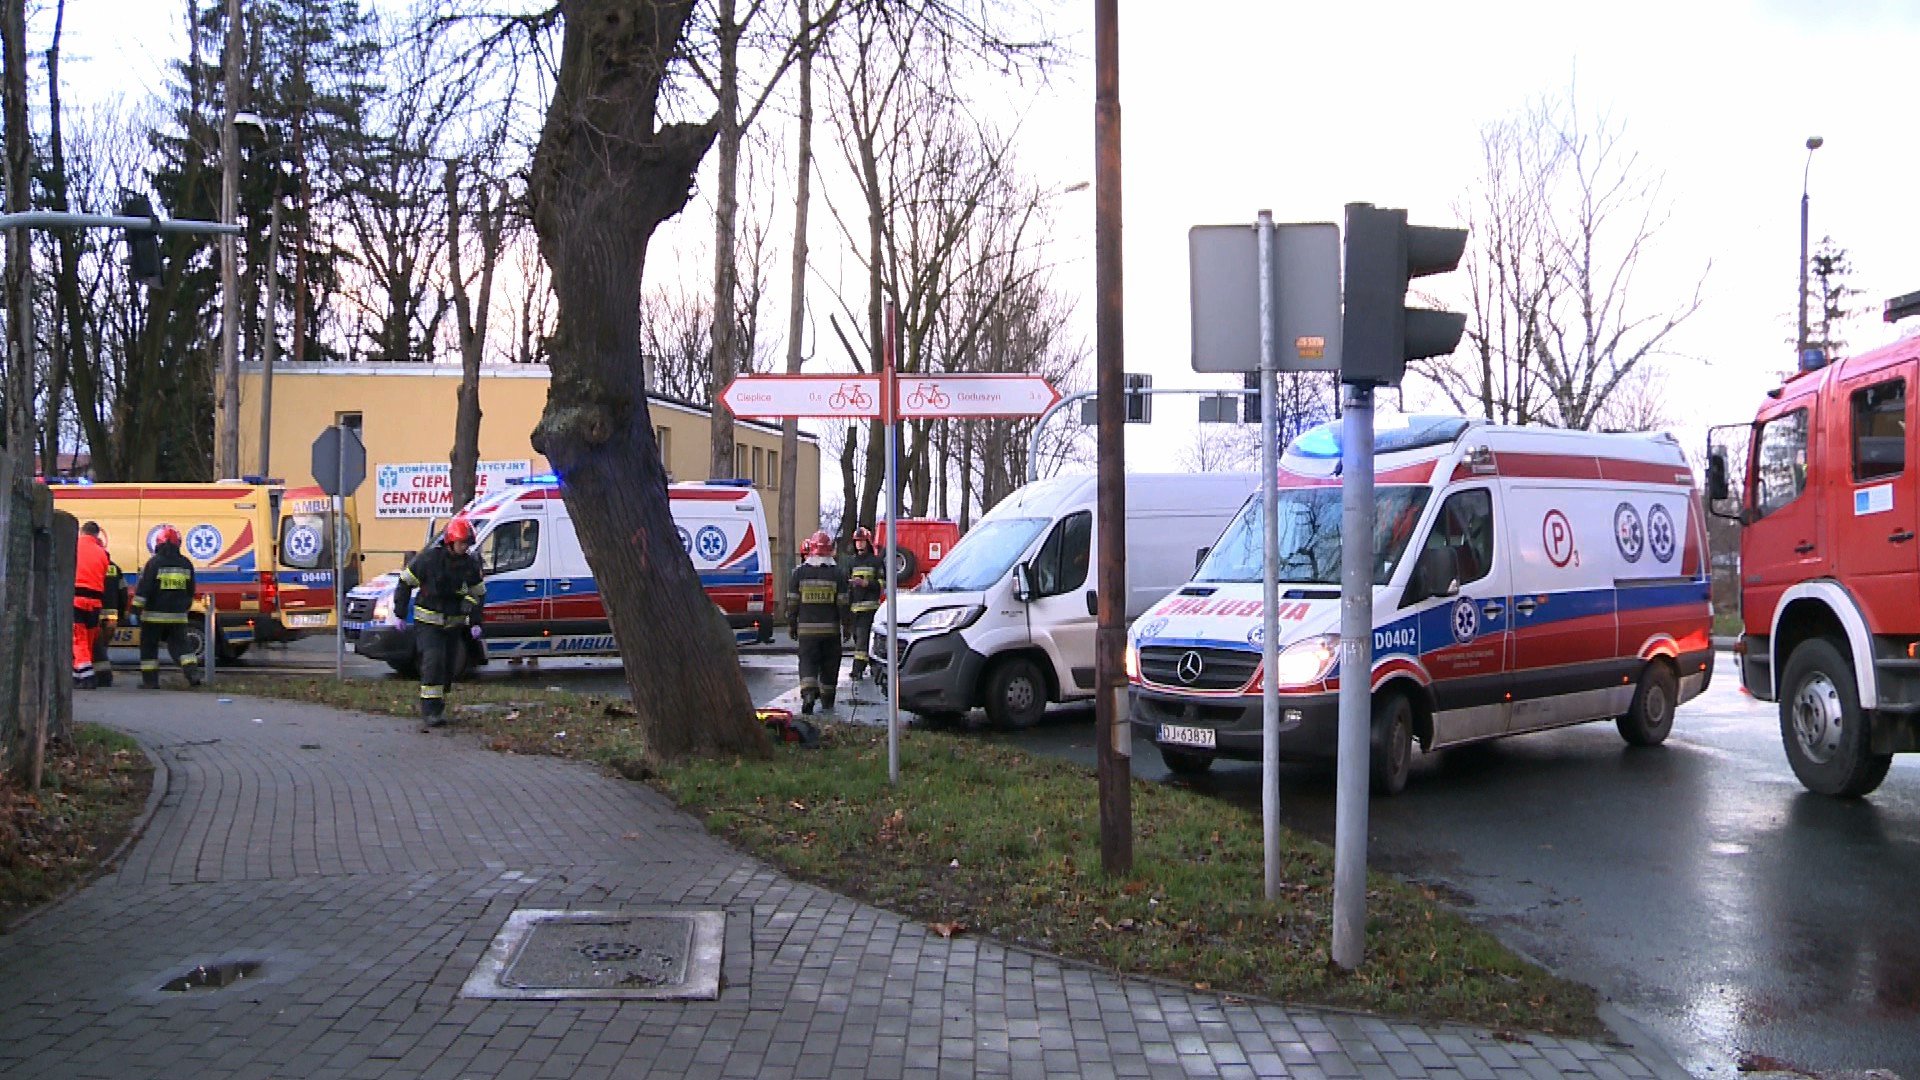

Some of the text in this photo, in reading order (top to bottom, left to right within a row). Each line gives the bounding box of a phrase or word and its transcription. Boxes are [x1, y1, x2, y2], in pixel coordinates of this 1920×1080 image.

[736, 392, 772, 403] Cieplice
[957, 392, 1001, 403] Goduszyn
[399, 465, 449, 474] KOMPLEKS
[383, 490, 453, 504] CENTRUM
[378, 505, 454, 514] www.centru
[1551, 521, 1564, 555] P
[1573, 549, 1580, 567] 3
[555, 636, 617, 650] AMBUL
[1375, 628, 1416, 650] D0402
